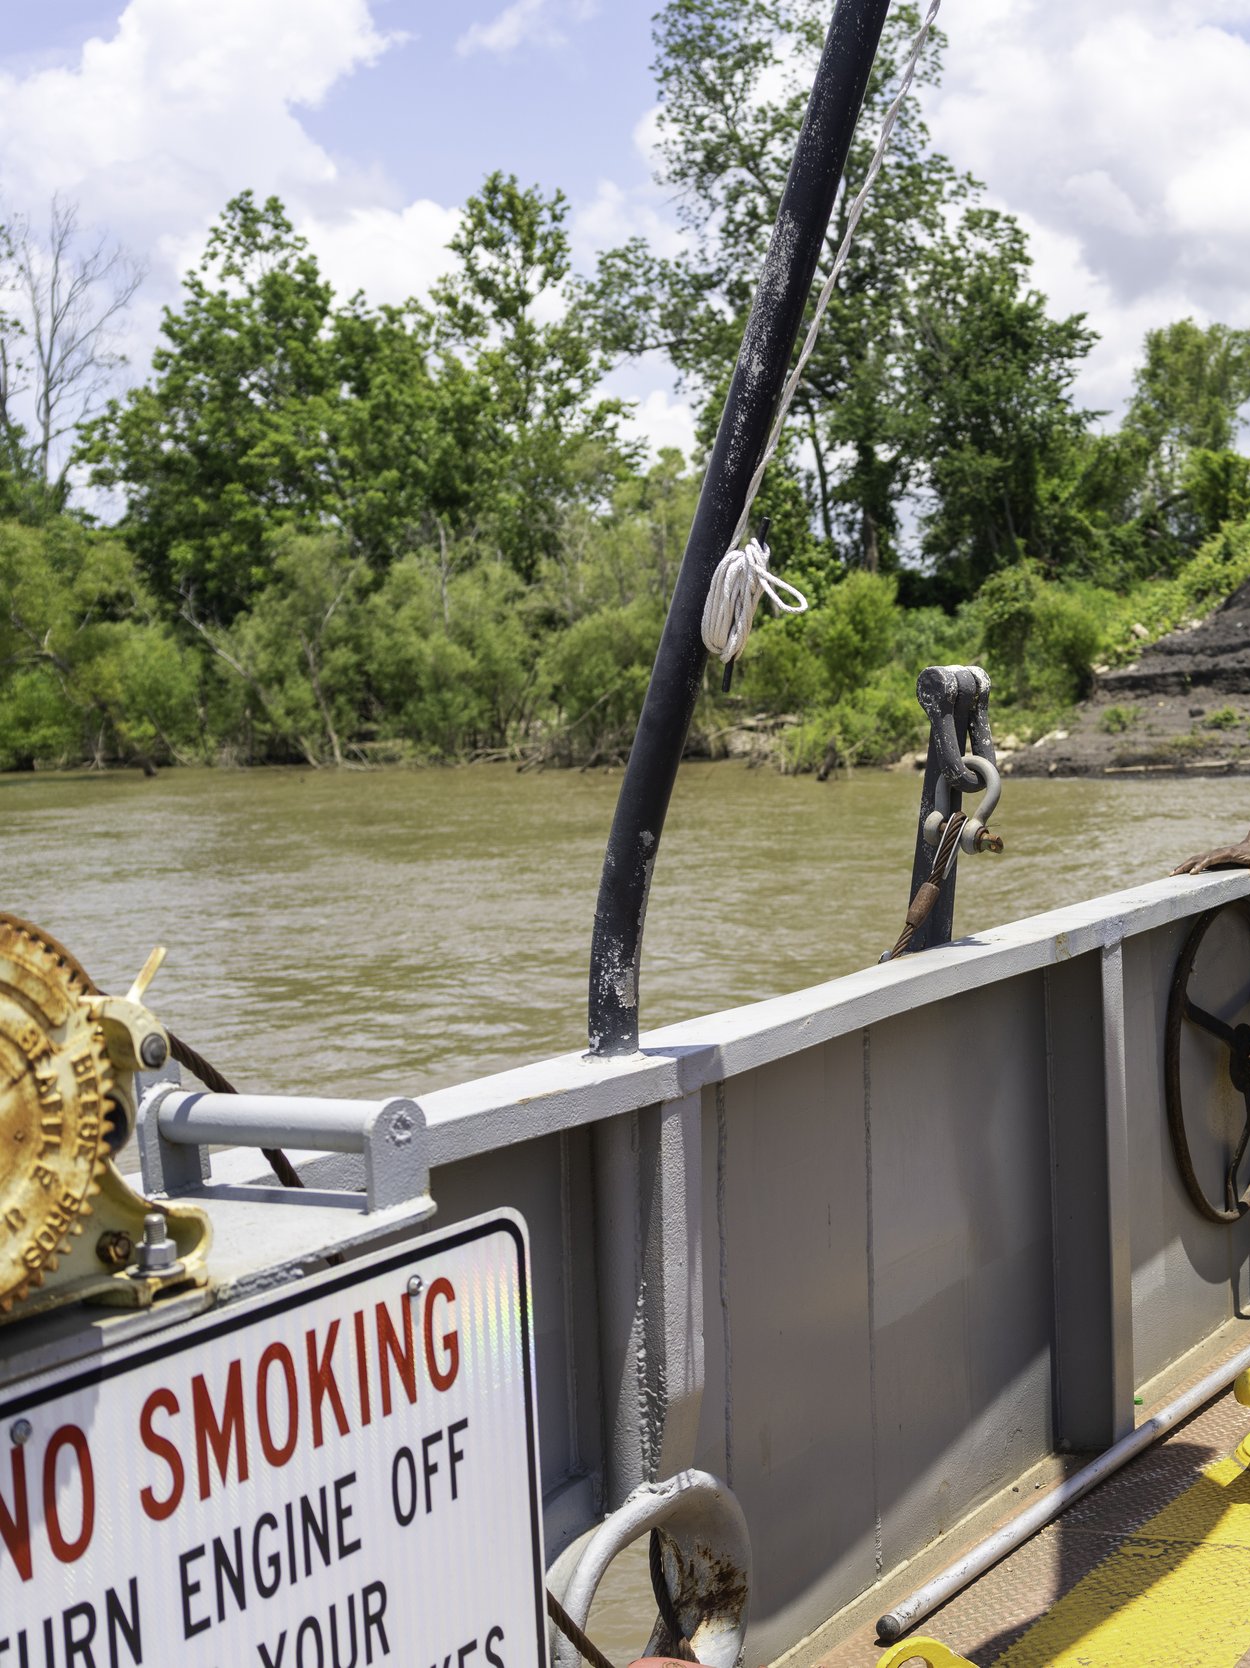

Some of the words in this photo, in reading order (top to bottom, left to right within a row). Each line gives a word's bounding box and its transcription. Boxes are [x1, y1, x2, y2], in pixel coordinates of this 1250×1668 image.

[0, 1424, 95, 1582] NO
[139, 1277, 460, 1521] SMOKING
[179, 1471, 362, 1640] ENGINE
[392, 1418, 469, 1527] OFF
